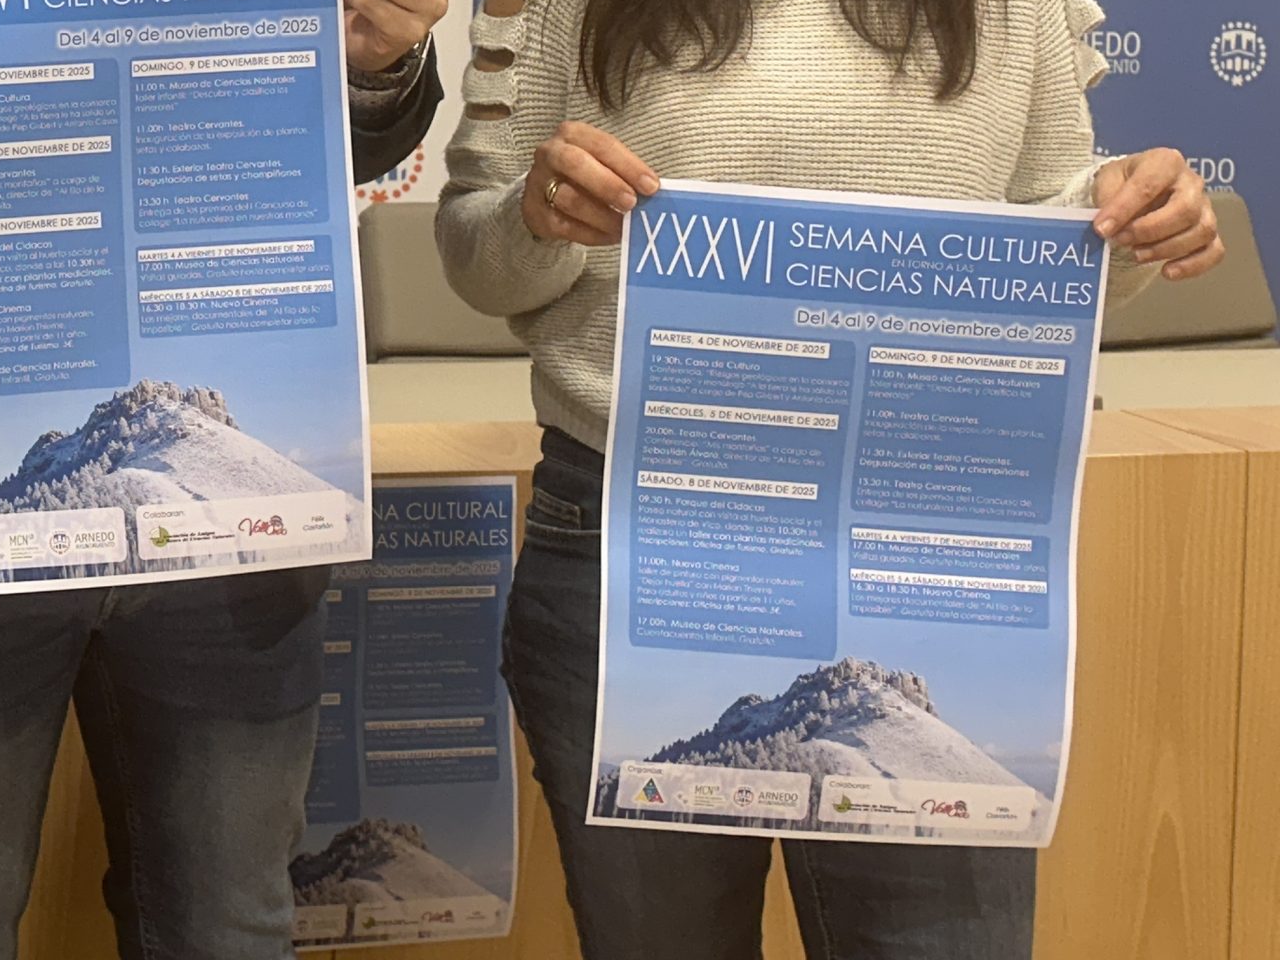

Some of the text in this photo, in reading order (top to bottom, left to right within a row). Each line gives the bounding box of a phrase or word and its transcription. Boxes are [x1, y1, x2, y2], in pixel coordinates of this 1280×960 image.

[59, 17, 318, 47] Del 4 al 9 de noviembre de 2025
[51, 67, 65, 78] DE
[67, 66, 90, 77] 2025
[189, 60, 195, 71] 9
[198, 59, 211, 70] DE
[214, 56, 268, 69] NOVIEMBRE
[272, 55, 285, 66] DE
[287, 53, 310, 65] 2025
[0, 218, 57, 231] NOVIEMBRE
[60, 217, 73, 226] DE
[76, 215, 98, 225] 2025
[636, 210, 775, 284] XXXVI
[788, 221, 1096, 268] SEMANA CULTURAL
[891, 259, 973, 272] EN TORNO A LAS
[785, 263, 1092, 306] CIENCIAS NATURALES
[797, 309, 1073, 342] Del 4 al 9 de noviembre de 2025
[688, 479, 694, 487] 8
[697, 480, 710, 488] DE
[713, 481, 772, 493] NOVIEMBRE
[775, 485, 789, 494] DE
[791, 486, 814, 496] 2025
[406, 500, 508, 521] CULTURAL
[75, 531, 115, 543] ARNEDO
[404, 528, 508, 548] NATURALES
